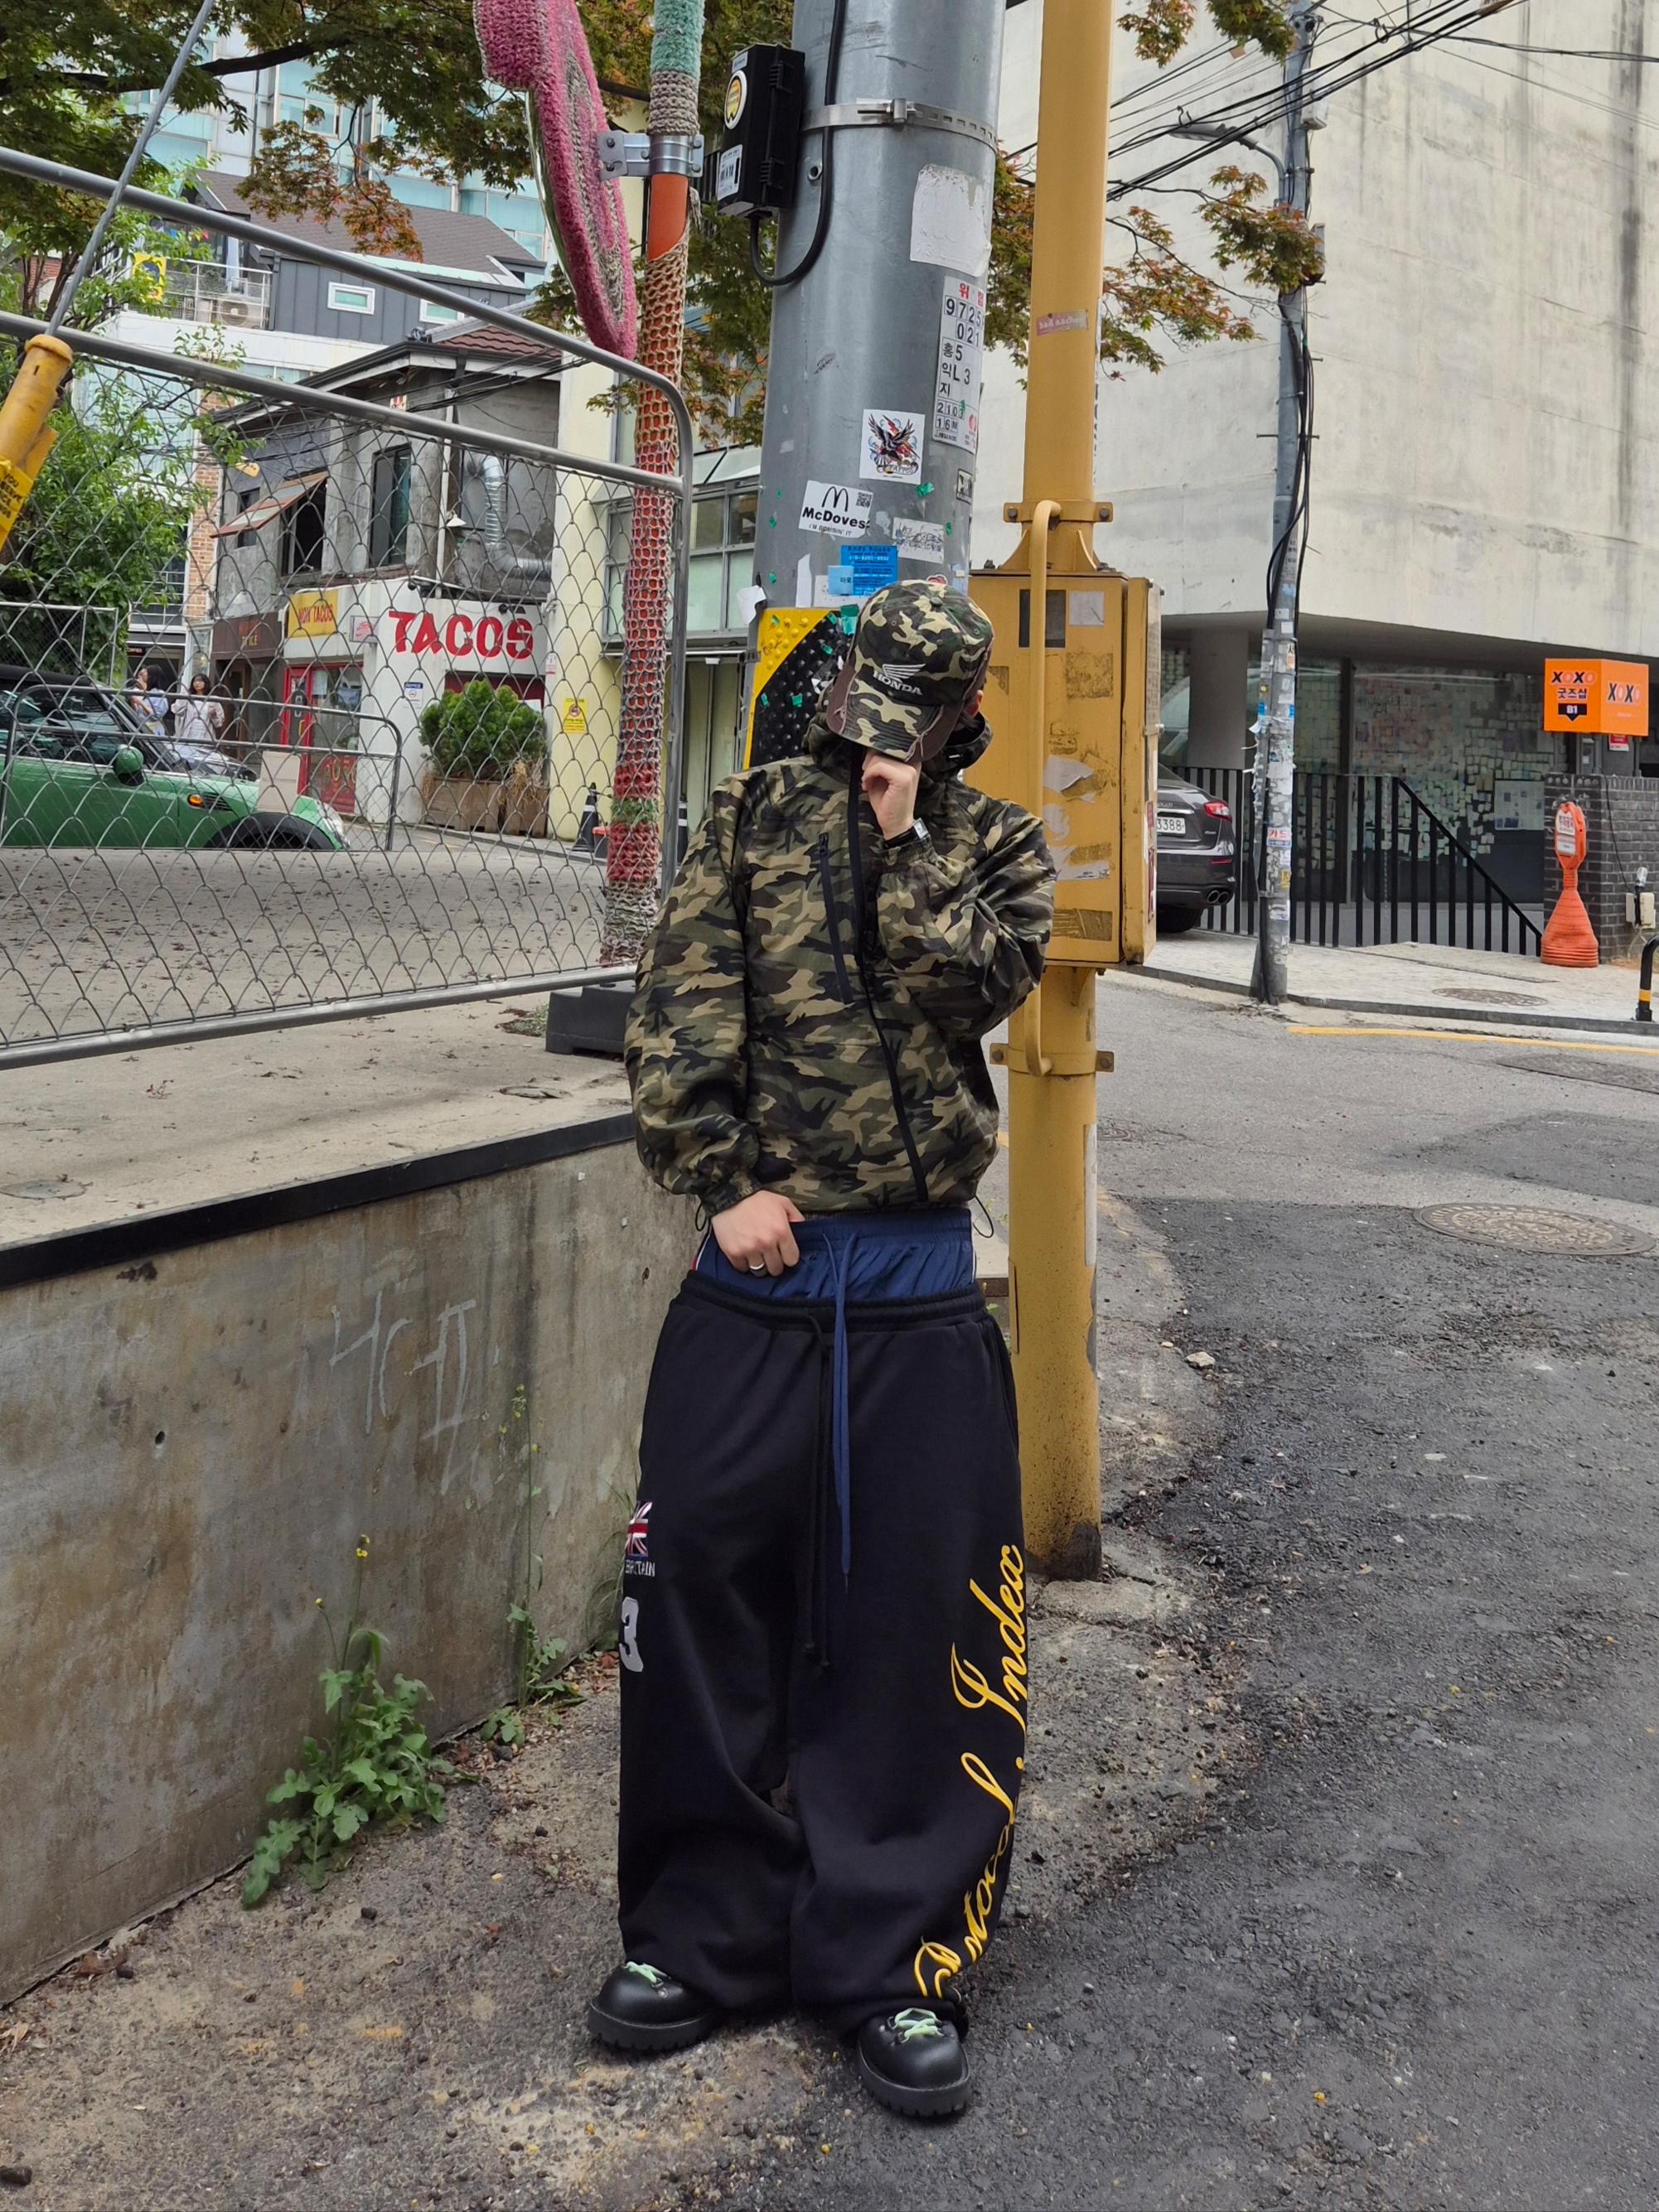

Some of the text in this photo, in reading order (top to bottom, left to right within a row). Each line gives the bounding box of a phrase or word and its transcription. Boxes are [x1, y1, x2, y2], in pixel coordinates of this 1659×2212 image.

[946, 298, 981, 328] 9725
[957, 322, 979, 347] 021
[937, 402, 964, 420] 2103
[937, 418, 958, 431] 16M
[313, 603, 334, 623] TACOS
[389, 611, 534, 659] TACOS
[873, 669, 922, 695] HONDA
[1551, 671, 1595, 684] XOXO
[1608, 682, 1640, 703] XOXO
[1566, 704, 1578, 714] B1
[951, 1544, 1028, 1737] Index
